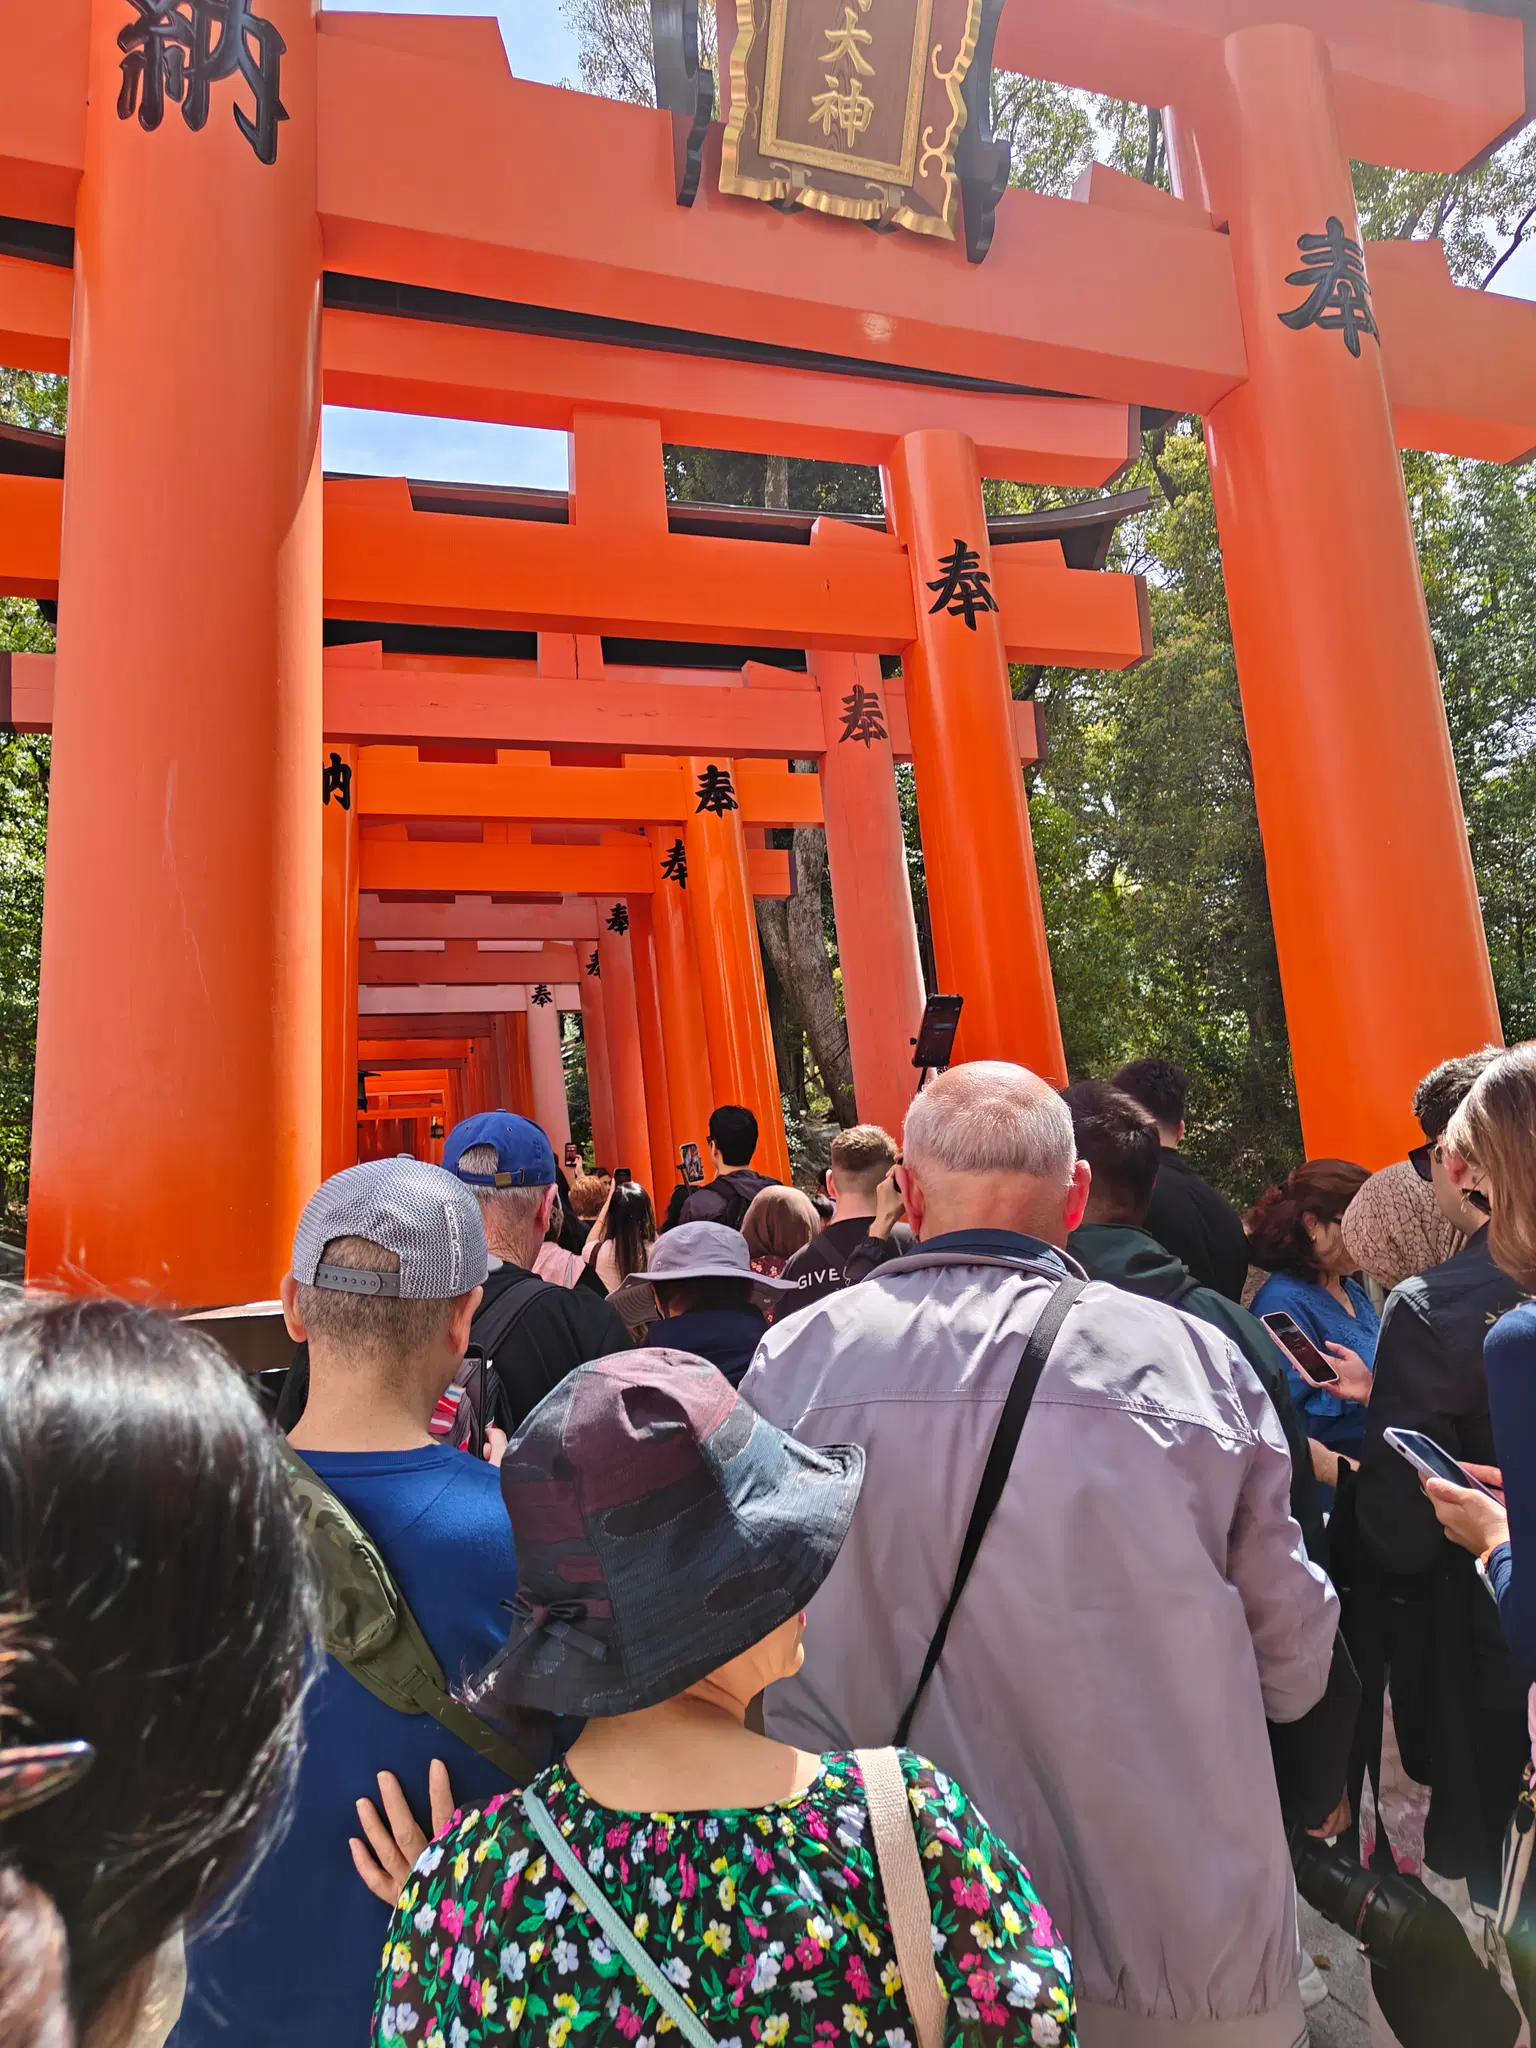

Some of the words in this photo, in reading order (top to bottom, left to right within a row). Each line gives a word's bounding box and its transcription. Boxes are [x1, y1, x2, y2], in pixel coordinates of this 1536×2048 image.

[808, 0, 876, 148] 大神
[1277, 216, 1380, 358] 奉
[925, 539, 999, 631] 奉
[838, 684, 888, 749] 奉
[695, 764, 739, 818] 奉
[660, 838, 688, 890] 奉
[606, 903, 629, 936] 奉
[531, 984, 553, 1008] 奉
[451, 1242, 460, 1288] ARMOUR
[797, 1268, 840, 1290] GIVE
